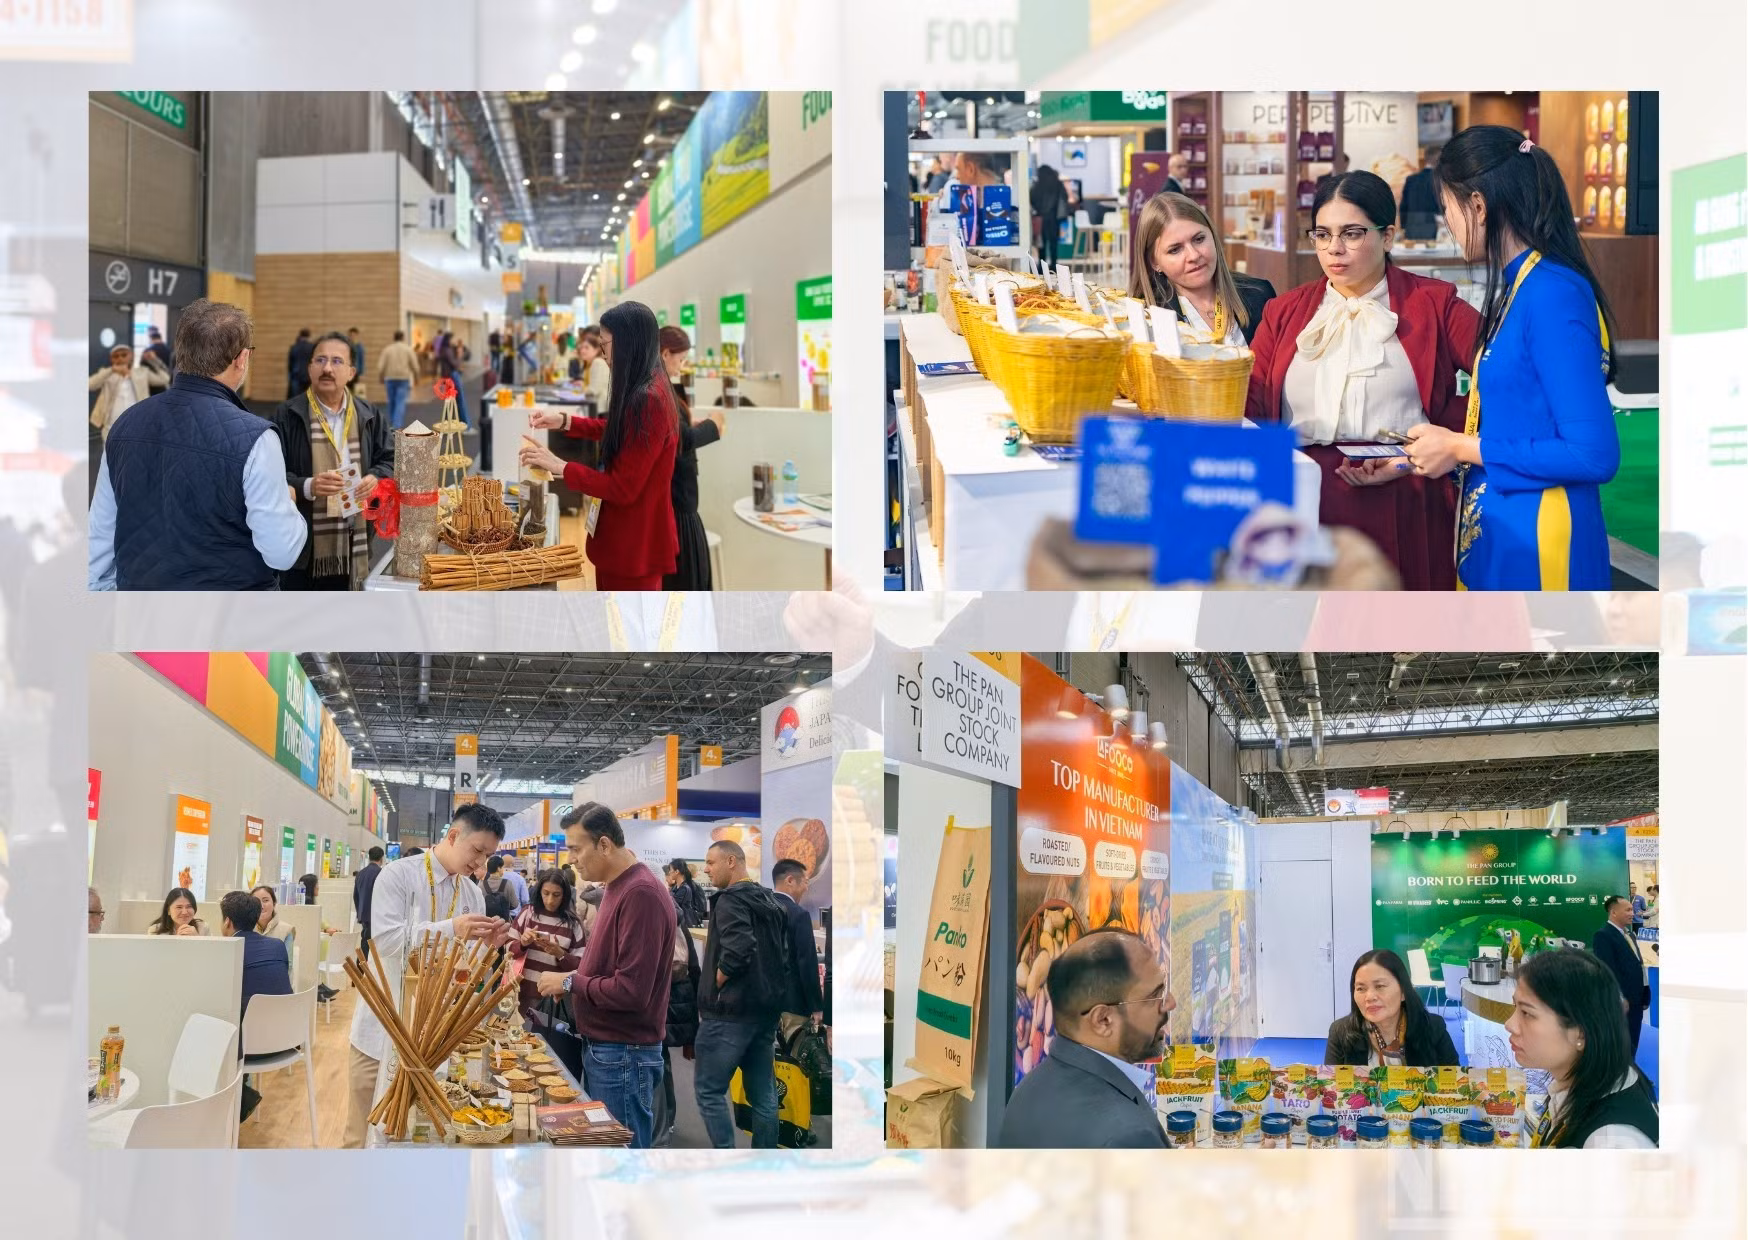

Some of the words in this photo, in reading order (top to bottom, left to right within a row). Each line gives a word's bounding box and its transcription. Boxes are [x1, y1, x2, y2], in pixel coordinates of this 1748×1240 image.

[147, 267, 179, 296] H7
[953, 660, 977, 692] THE
[981, 677, 1004, 706] PAN
[931, 676, 984, 717] GROUP
[985, 703, 1017, 734] JOINT
[959, 713, 999, 748] STOCK
[944, 732, 1010, 772] COMPANY
[460, 772, 472, 788] R
[1050, 759, 1081, 793] TOP
[1083, 775, 1160, 823] MANUFACTURER
[1085, 806, 1098, 830] IN
[1098, 810, 1143, 841] VIETNAM
[1029, 853, 1066, 867] FLAVOURED
[1493, 861, 1516, 869] GROUP
[1407, 876, 1444, 887] BORN
[1445, 875, 1464, 886] TO
[1466, 875, 1500, 886] FEED
[1501, 875, 1527, 885] THE
[1528, 874, 1577, 885] WORLD
[933, 920, 968, 949] Panko
[923, 955, 968, 989] パン粉
[944, 1046, 961, 1067] 10kg
[1281, 1098, 1311, 1109] TARO
